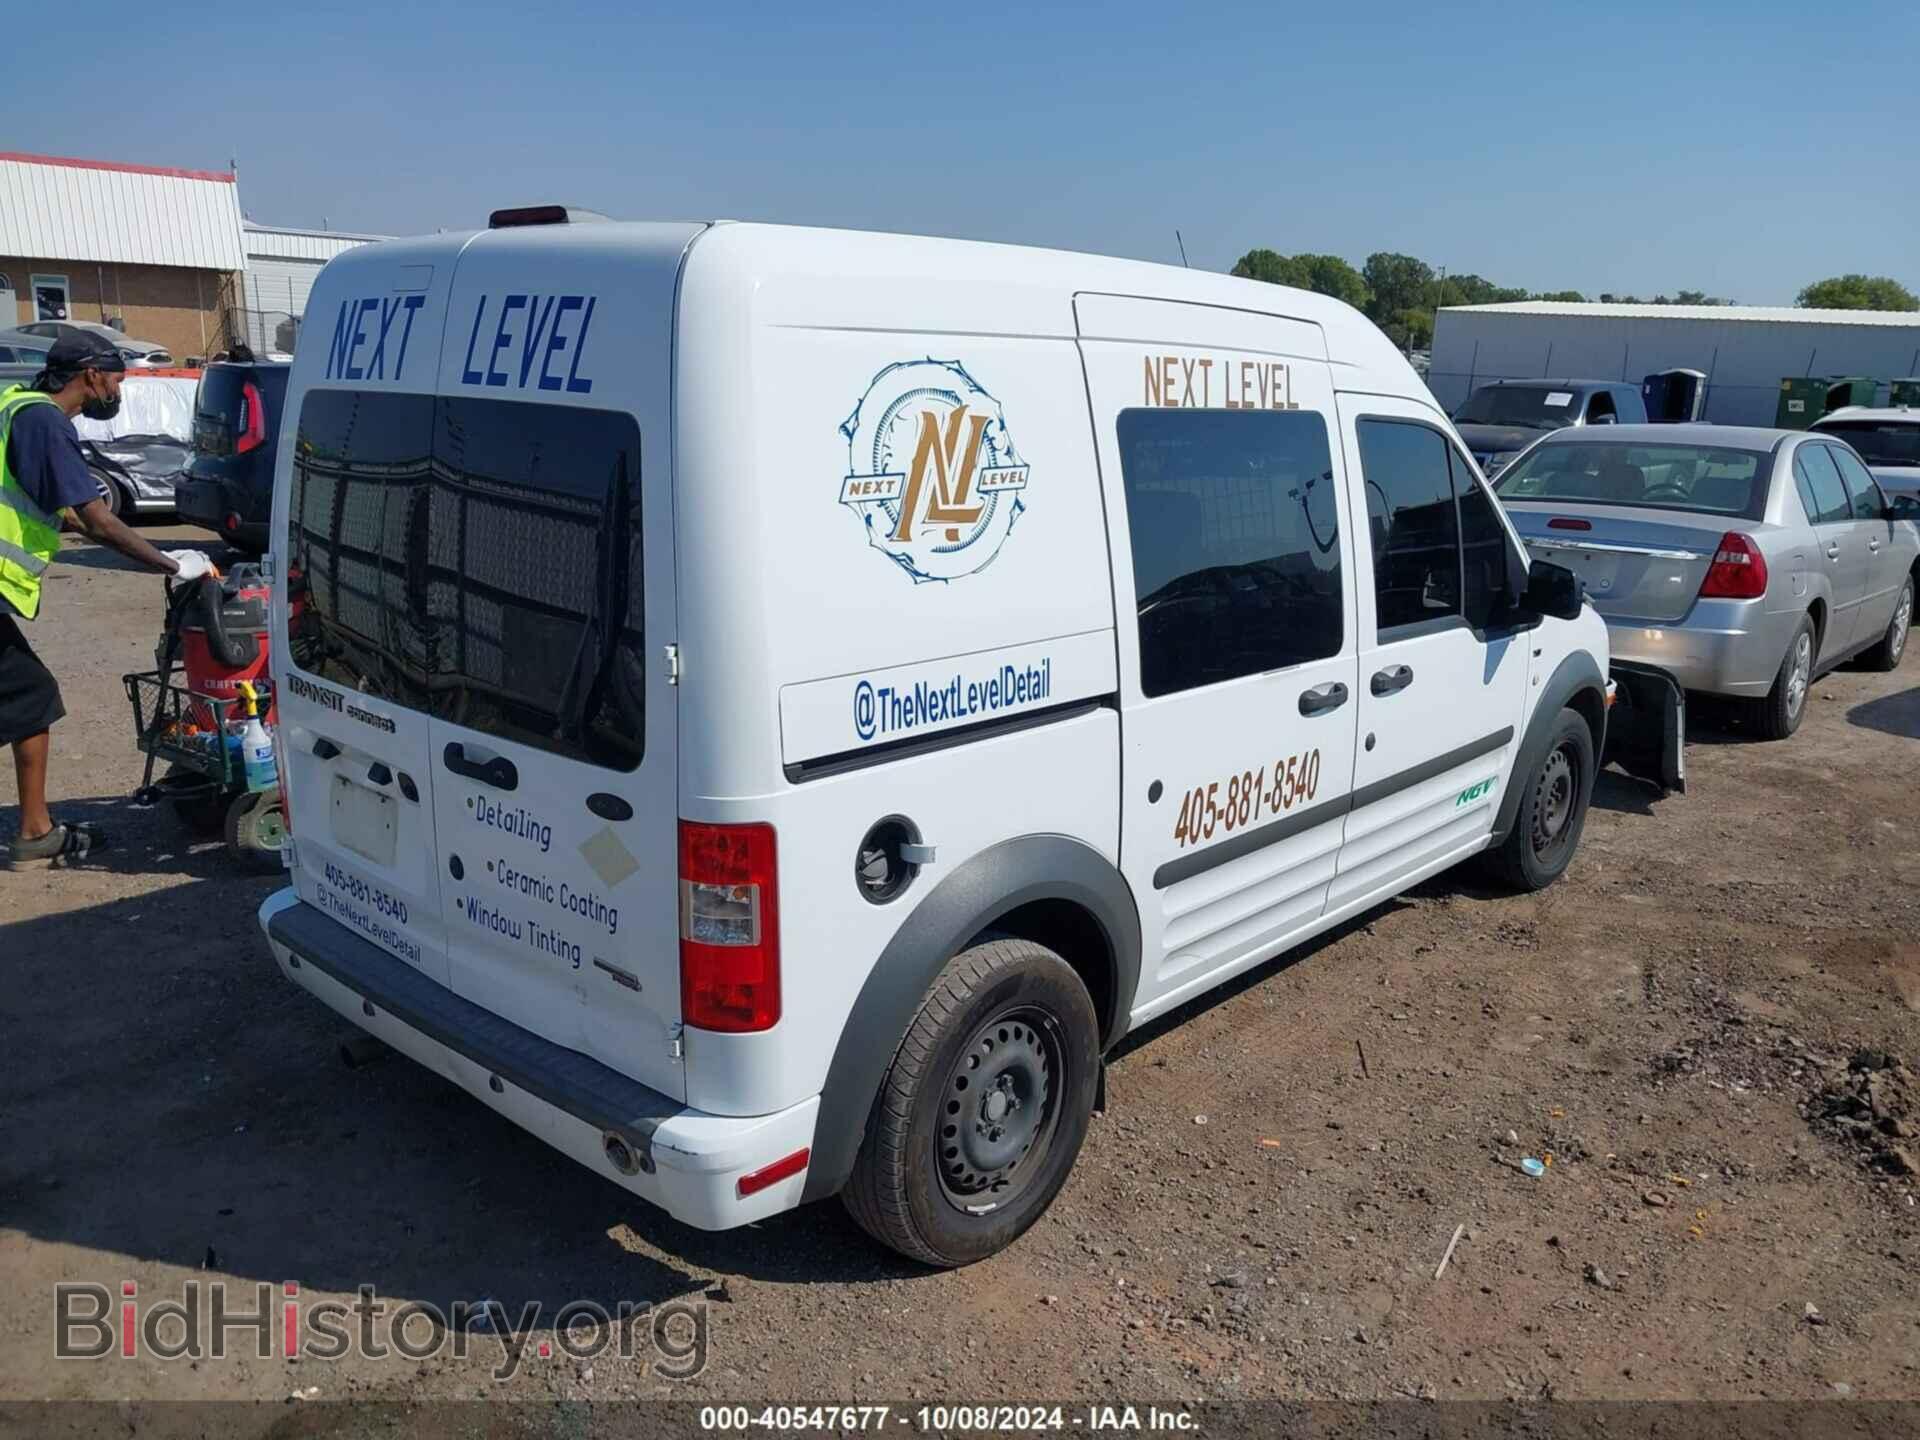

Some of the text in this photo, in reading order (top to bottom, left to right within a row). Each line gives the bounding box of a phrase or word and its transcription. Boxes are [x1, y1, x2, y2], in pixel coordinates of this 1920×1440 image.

[325, 294, 598, 394] NEXT LEVEL
[1144, 355, 1299, 409] NEXT LEVEL
[848, 480, 896, 496] NEXT
[981, 470, 1025, 486] LEVEL
[285, 672, 344, 713] TRANSIT
[854, 657, 1050, 741] @TheNextLevelDetail
[476, 795, 552, 852] Detailing
[1174, 748, 1320, 848] 405-881-8540
[317, 883, 420, 962] @TheNextLevelDetail
[325, 862, 408, 924] 405-881-8540
[497, 859, 618, 935] Ceramic Coating
[466, 896, 581, 969] Window Tinting
